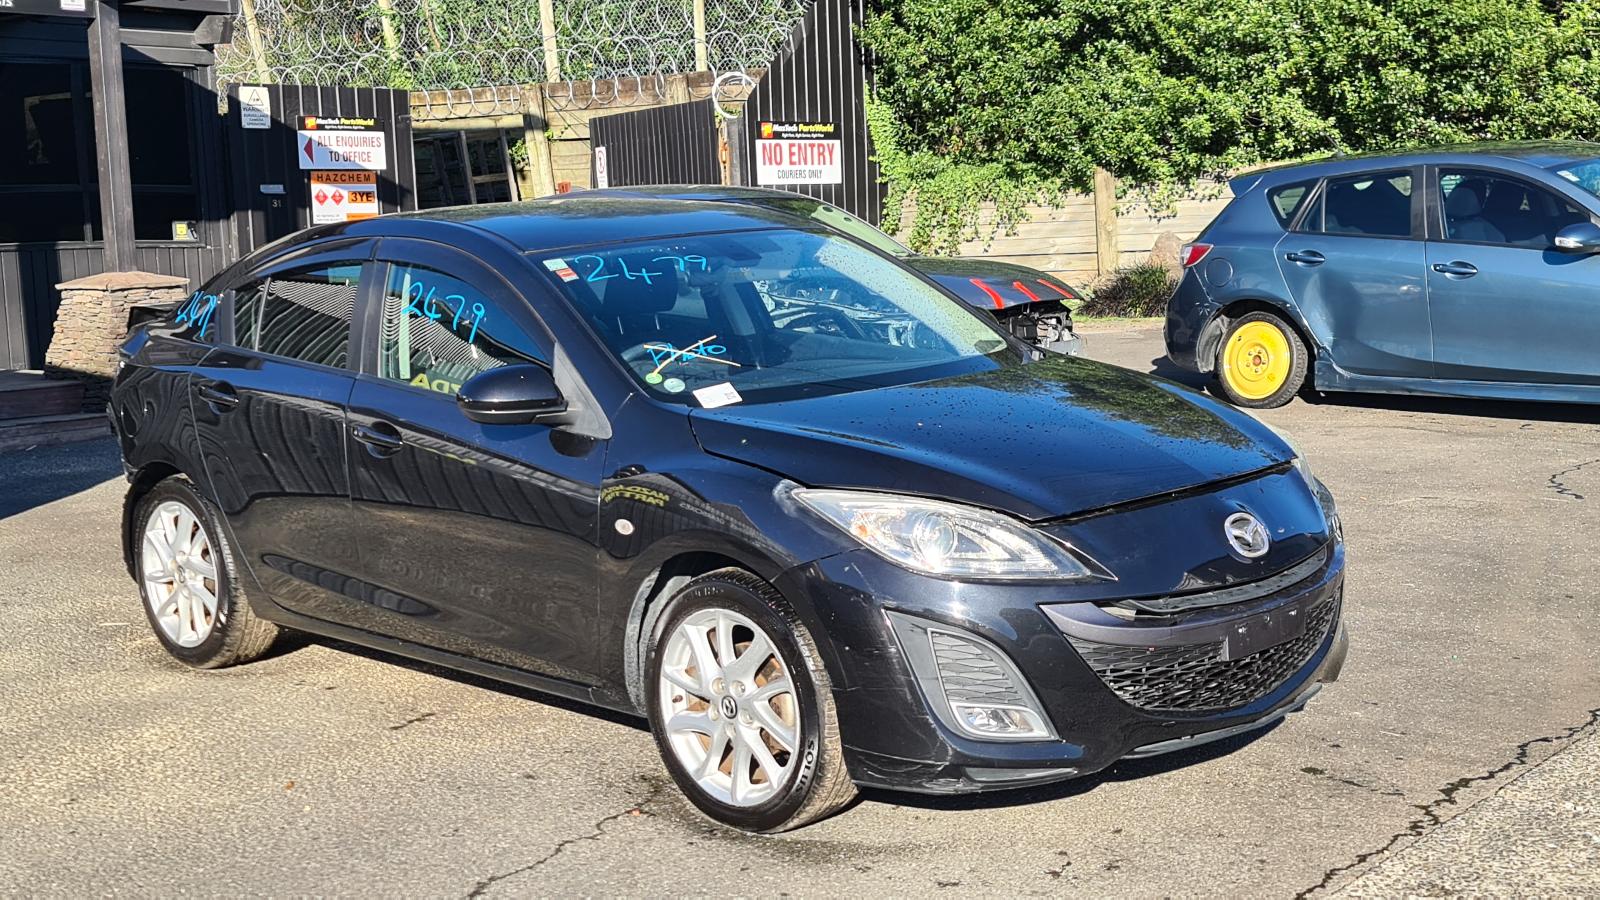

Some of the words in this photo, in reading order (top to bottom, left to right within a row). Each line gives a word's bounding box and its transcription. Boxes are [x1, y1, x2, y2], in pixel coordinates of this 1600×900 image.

[317, 136, 333, 147] ALL
[335, 136, 382, 148] ENQUIRIES
[329, 151, 340, 162] TO
[342, 151, 372, 162] OFFICE
[762, 143, 783, 166] NO
[788, 143, 835, 166] ENTRY
[316, 173, 371, 182] HAZCHEM
[777, 169, 807, 179] COURIERS
[808, 169, 822, 179] ONLY
[351, 191, 373, 202] 3YE
[272, 199, 281, 208] 31
[401, 281, 485, 344] 2479
[795, 740, 815, 792] SOLUS
